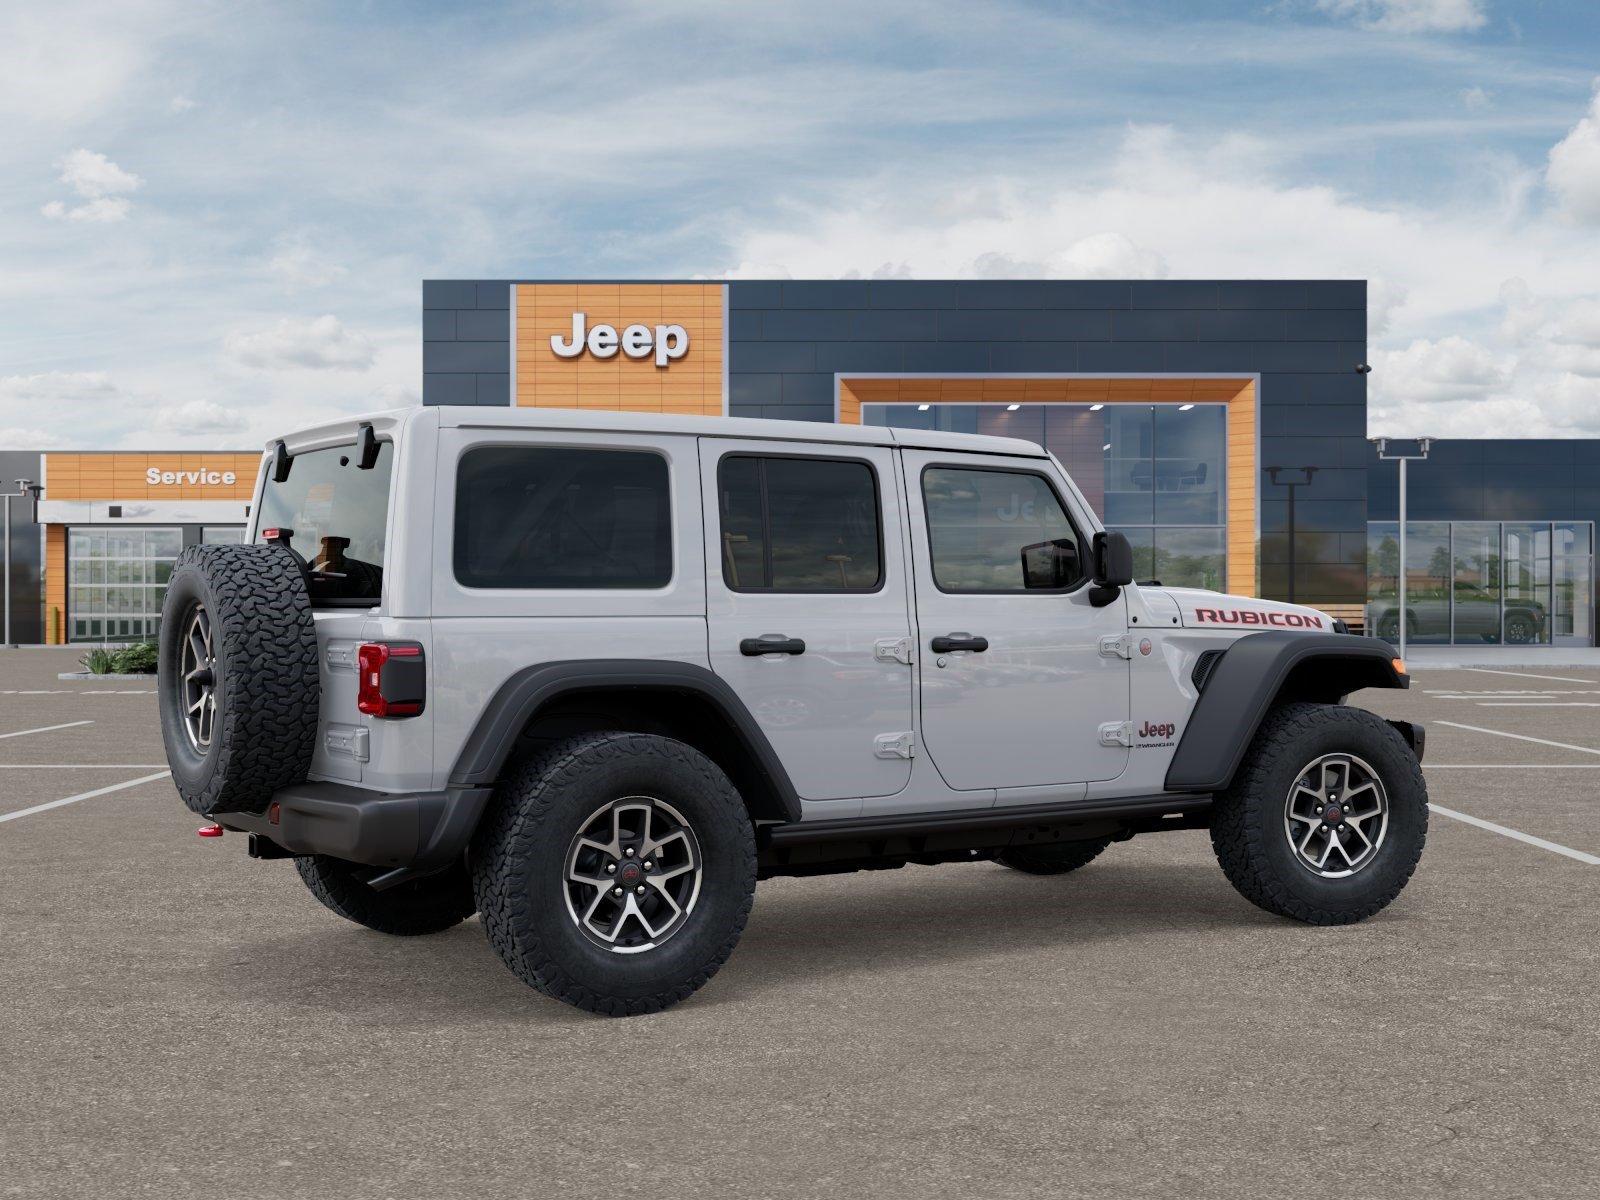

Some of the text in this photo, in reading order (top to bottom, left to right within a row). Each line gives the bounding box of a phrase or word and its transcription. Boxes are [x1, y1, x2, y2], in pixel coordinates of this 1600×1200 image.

[550, 312, 689, 367] Jeep
[146, 467, 237, 485] Service
[1194, 608, 1323, 629] RUBICON
[1138, 720, 1176, 739] Jeep
